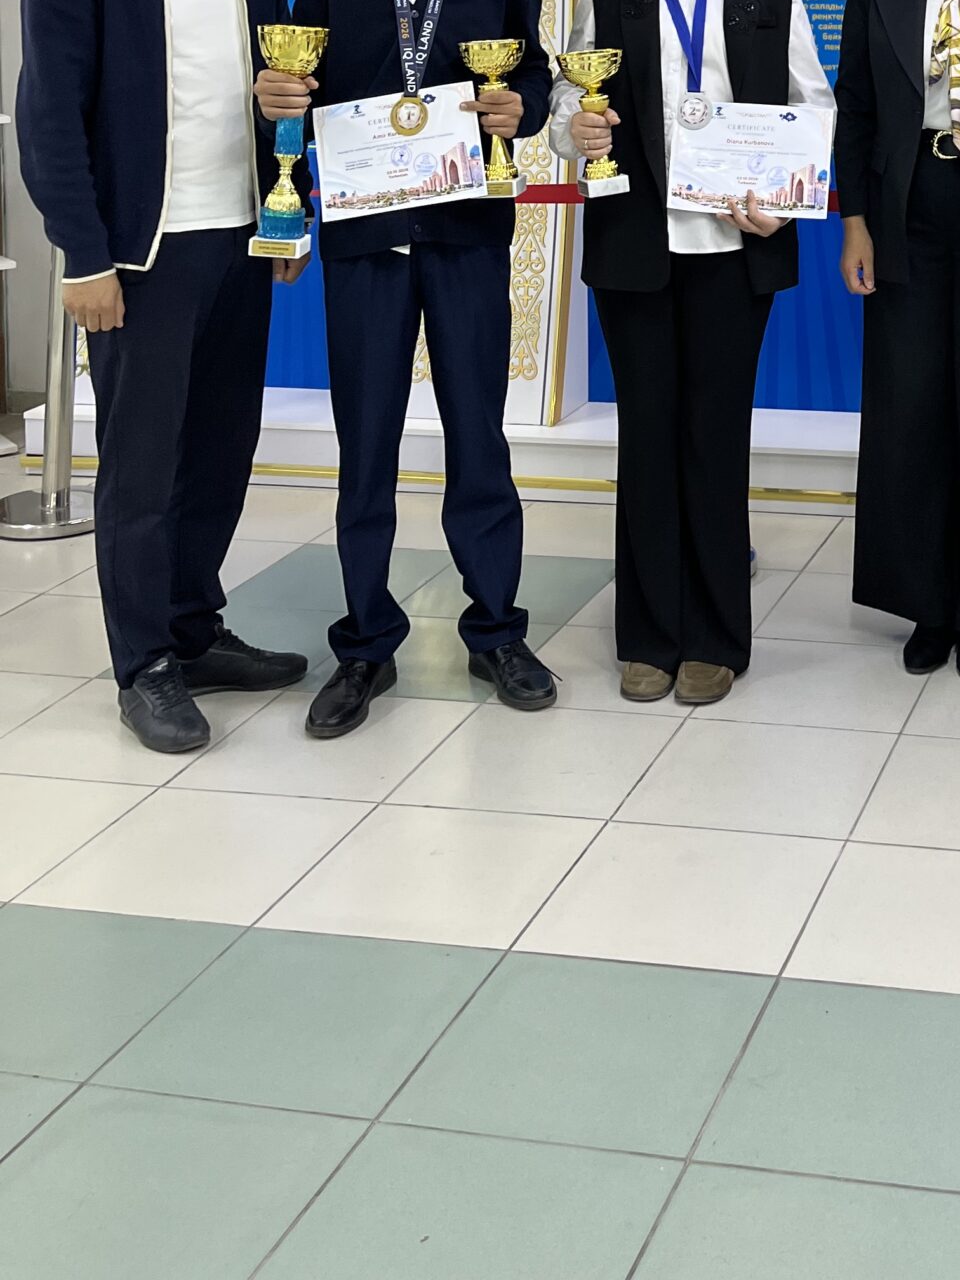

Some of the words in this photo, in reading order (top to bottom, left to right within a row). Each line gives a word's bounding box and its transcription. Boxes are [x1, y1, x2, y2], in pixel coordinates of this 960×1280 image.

[400, 18, 409, 39] 2026
[418, 20, 433, 50] LAND
[403, 48, 413, 60] IQ
[416, 52, 427, 64] IQ
[405, 62, 416, 92] LAND
